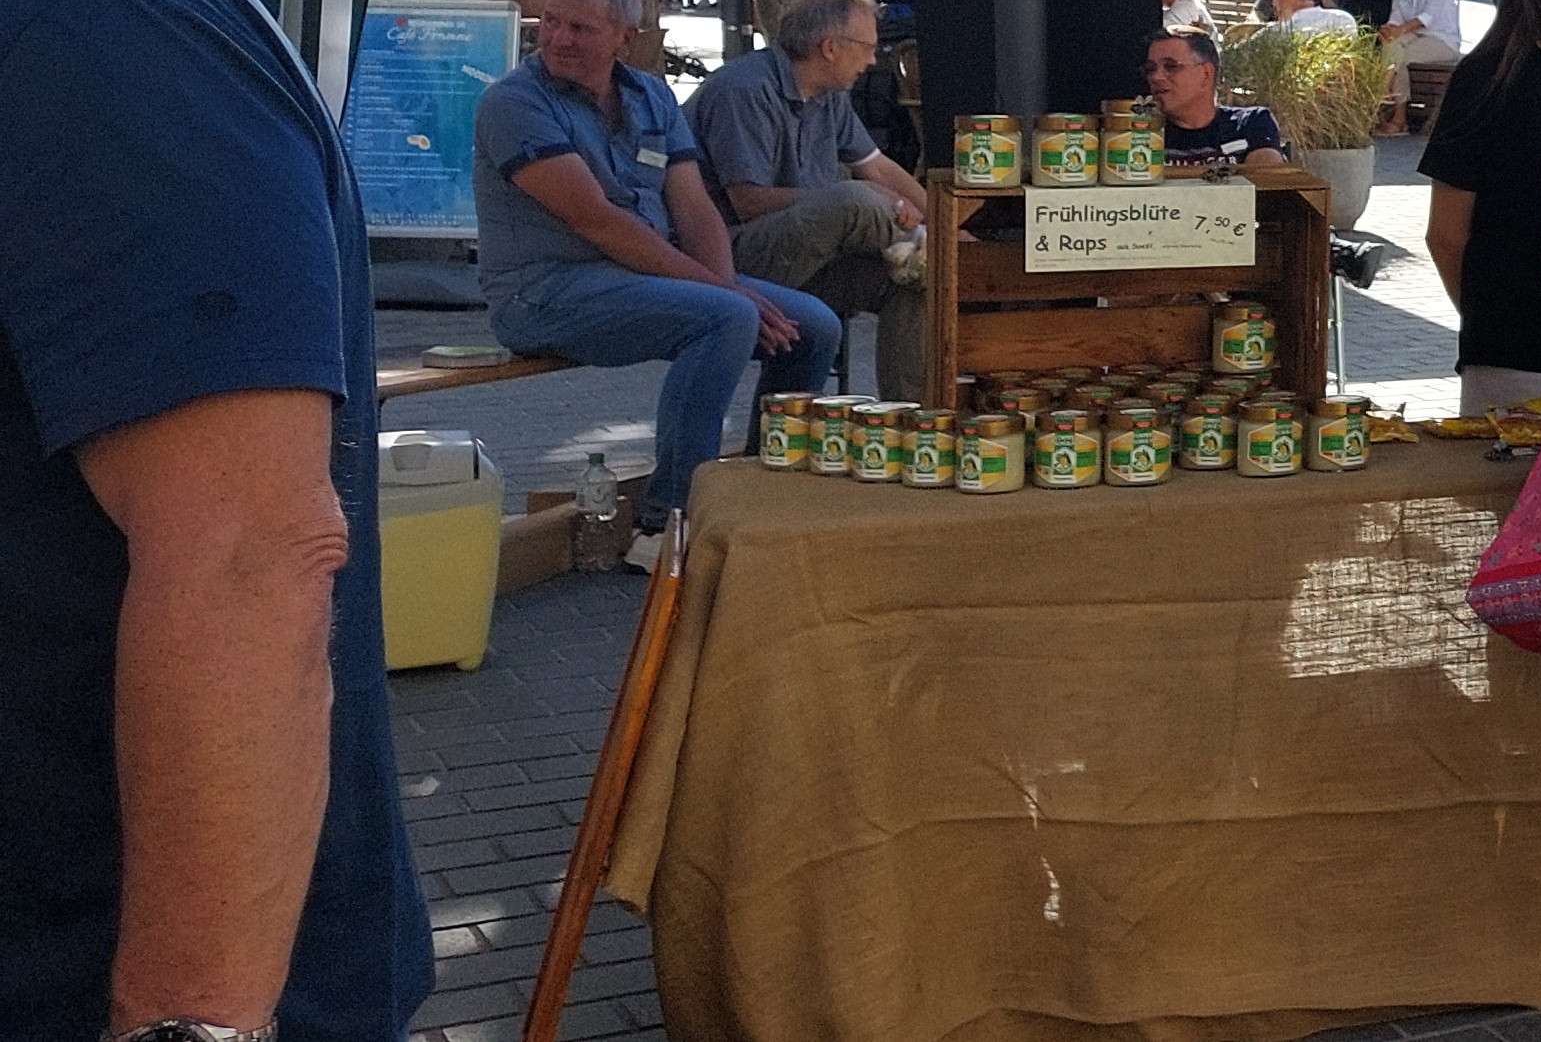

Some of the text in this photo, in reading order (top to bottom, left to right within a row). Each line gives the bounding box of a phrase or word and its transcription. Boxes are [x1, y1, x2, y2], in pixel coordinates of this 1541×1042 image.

[1035, 204, 1181, 226] Frühlingsblüte
[1035, 236, 1049, 251] &
[1059, 234, 1107, 255] Raps
